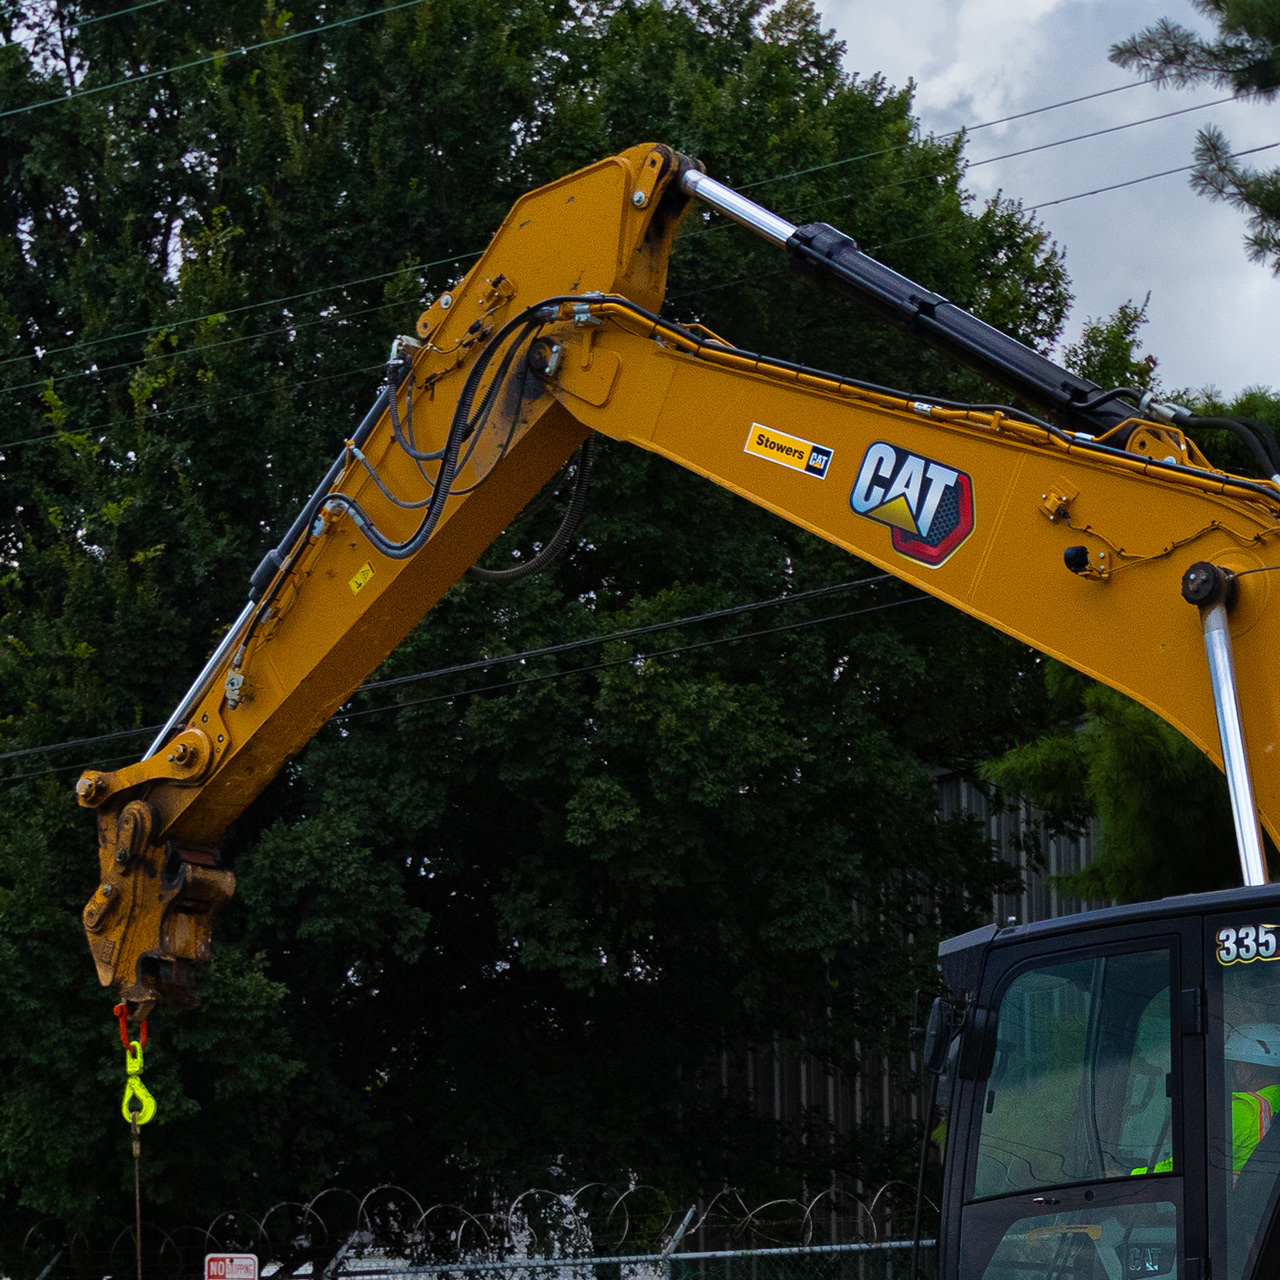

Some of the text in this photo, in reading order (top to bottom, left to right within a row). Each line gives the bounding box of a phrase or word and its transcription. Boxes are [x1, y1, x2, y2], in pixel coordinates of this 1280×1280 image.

[755, 433, 828, 470] Stowers CAT
[851, 443, 959, 538] CAT
[1219, 925, 1277, 961] 335
[209, 1261, 225, 1276] NO
